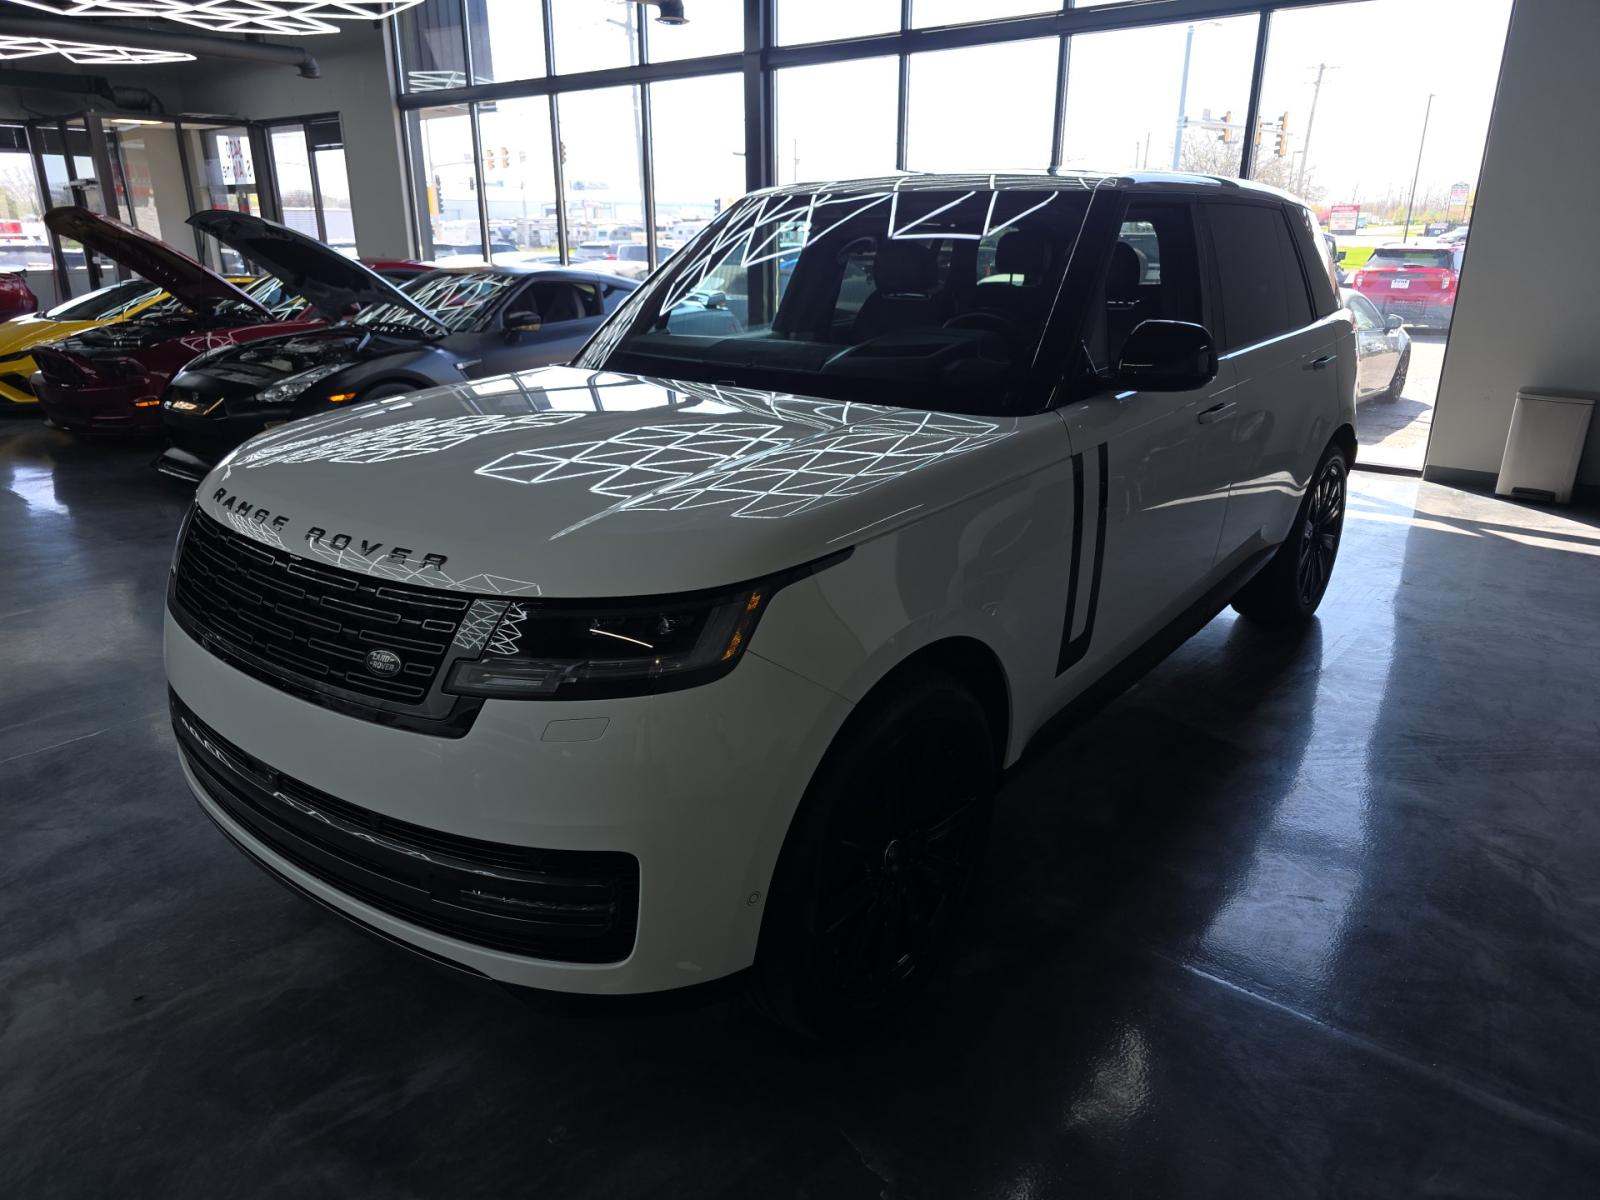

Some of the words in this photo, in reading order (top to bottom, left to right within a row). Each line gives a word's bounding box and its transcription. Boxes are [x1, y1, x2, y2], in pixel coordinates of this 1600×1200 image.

[213, 487, 289, 531] RANGE
[305, 527, 448, 571] ROVER
[372, 652, 391, 662] LAND
[372, 661, 395, 671] ROVER
